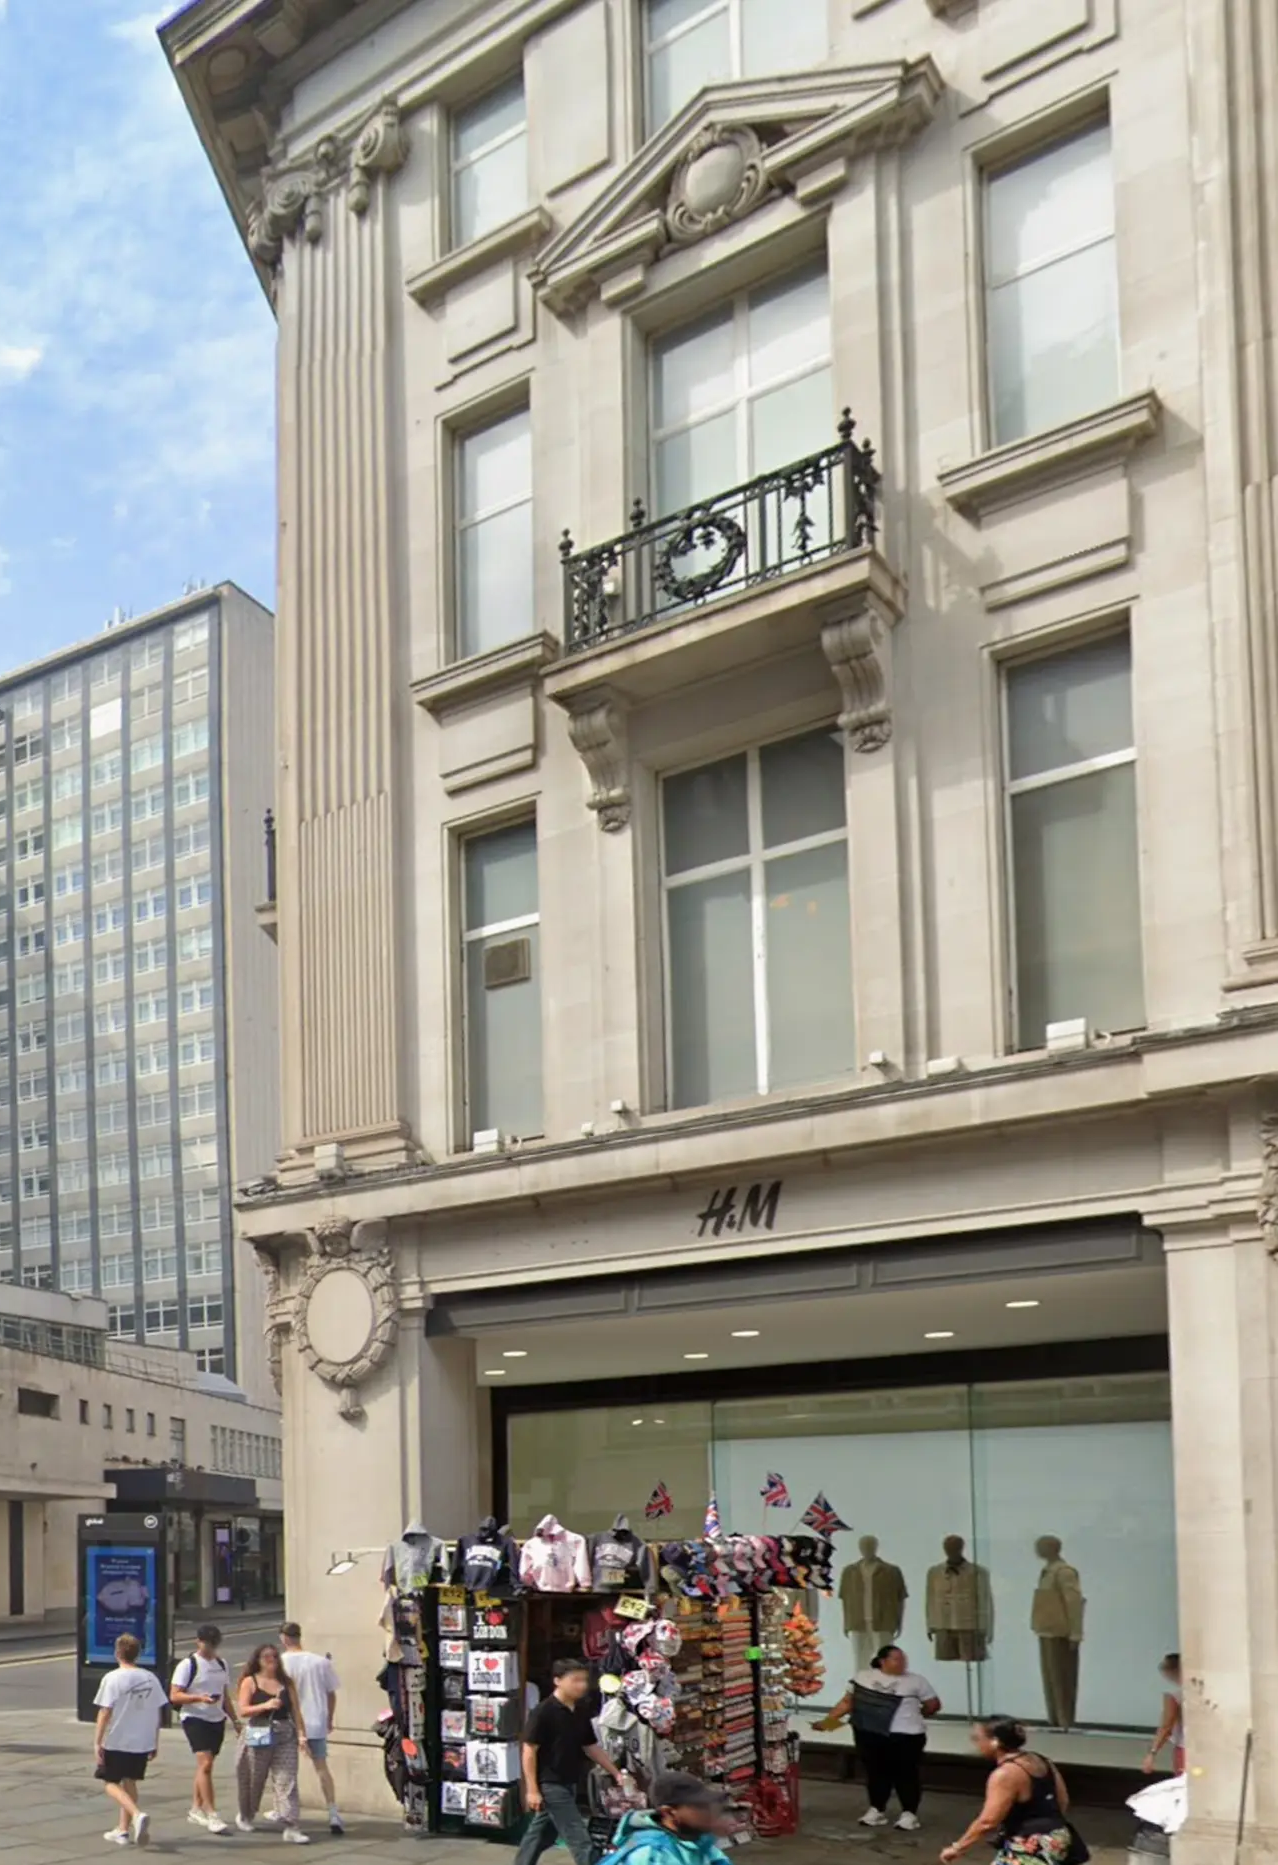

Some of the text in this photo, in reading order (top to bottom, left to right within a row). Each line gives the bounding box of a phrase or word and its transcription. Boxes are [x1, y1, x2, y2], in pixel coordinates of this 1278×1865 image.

[697, 1180, 782, 1237] H&M
[474, 1658, 481, 1671] I
[472, 1672, 501, 1684] LONDON
